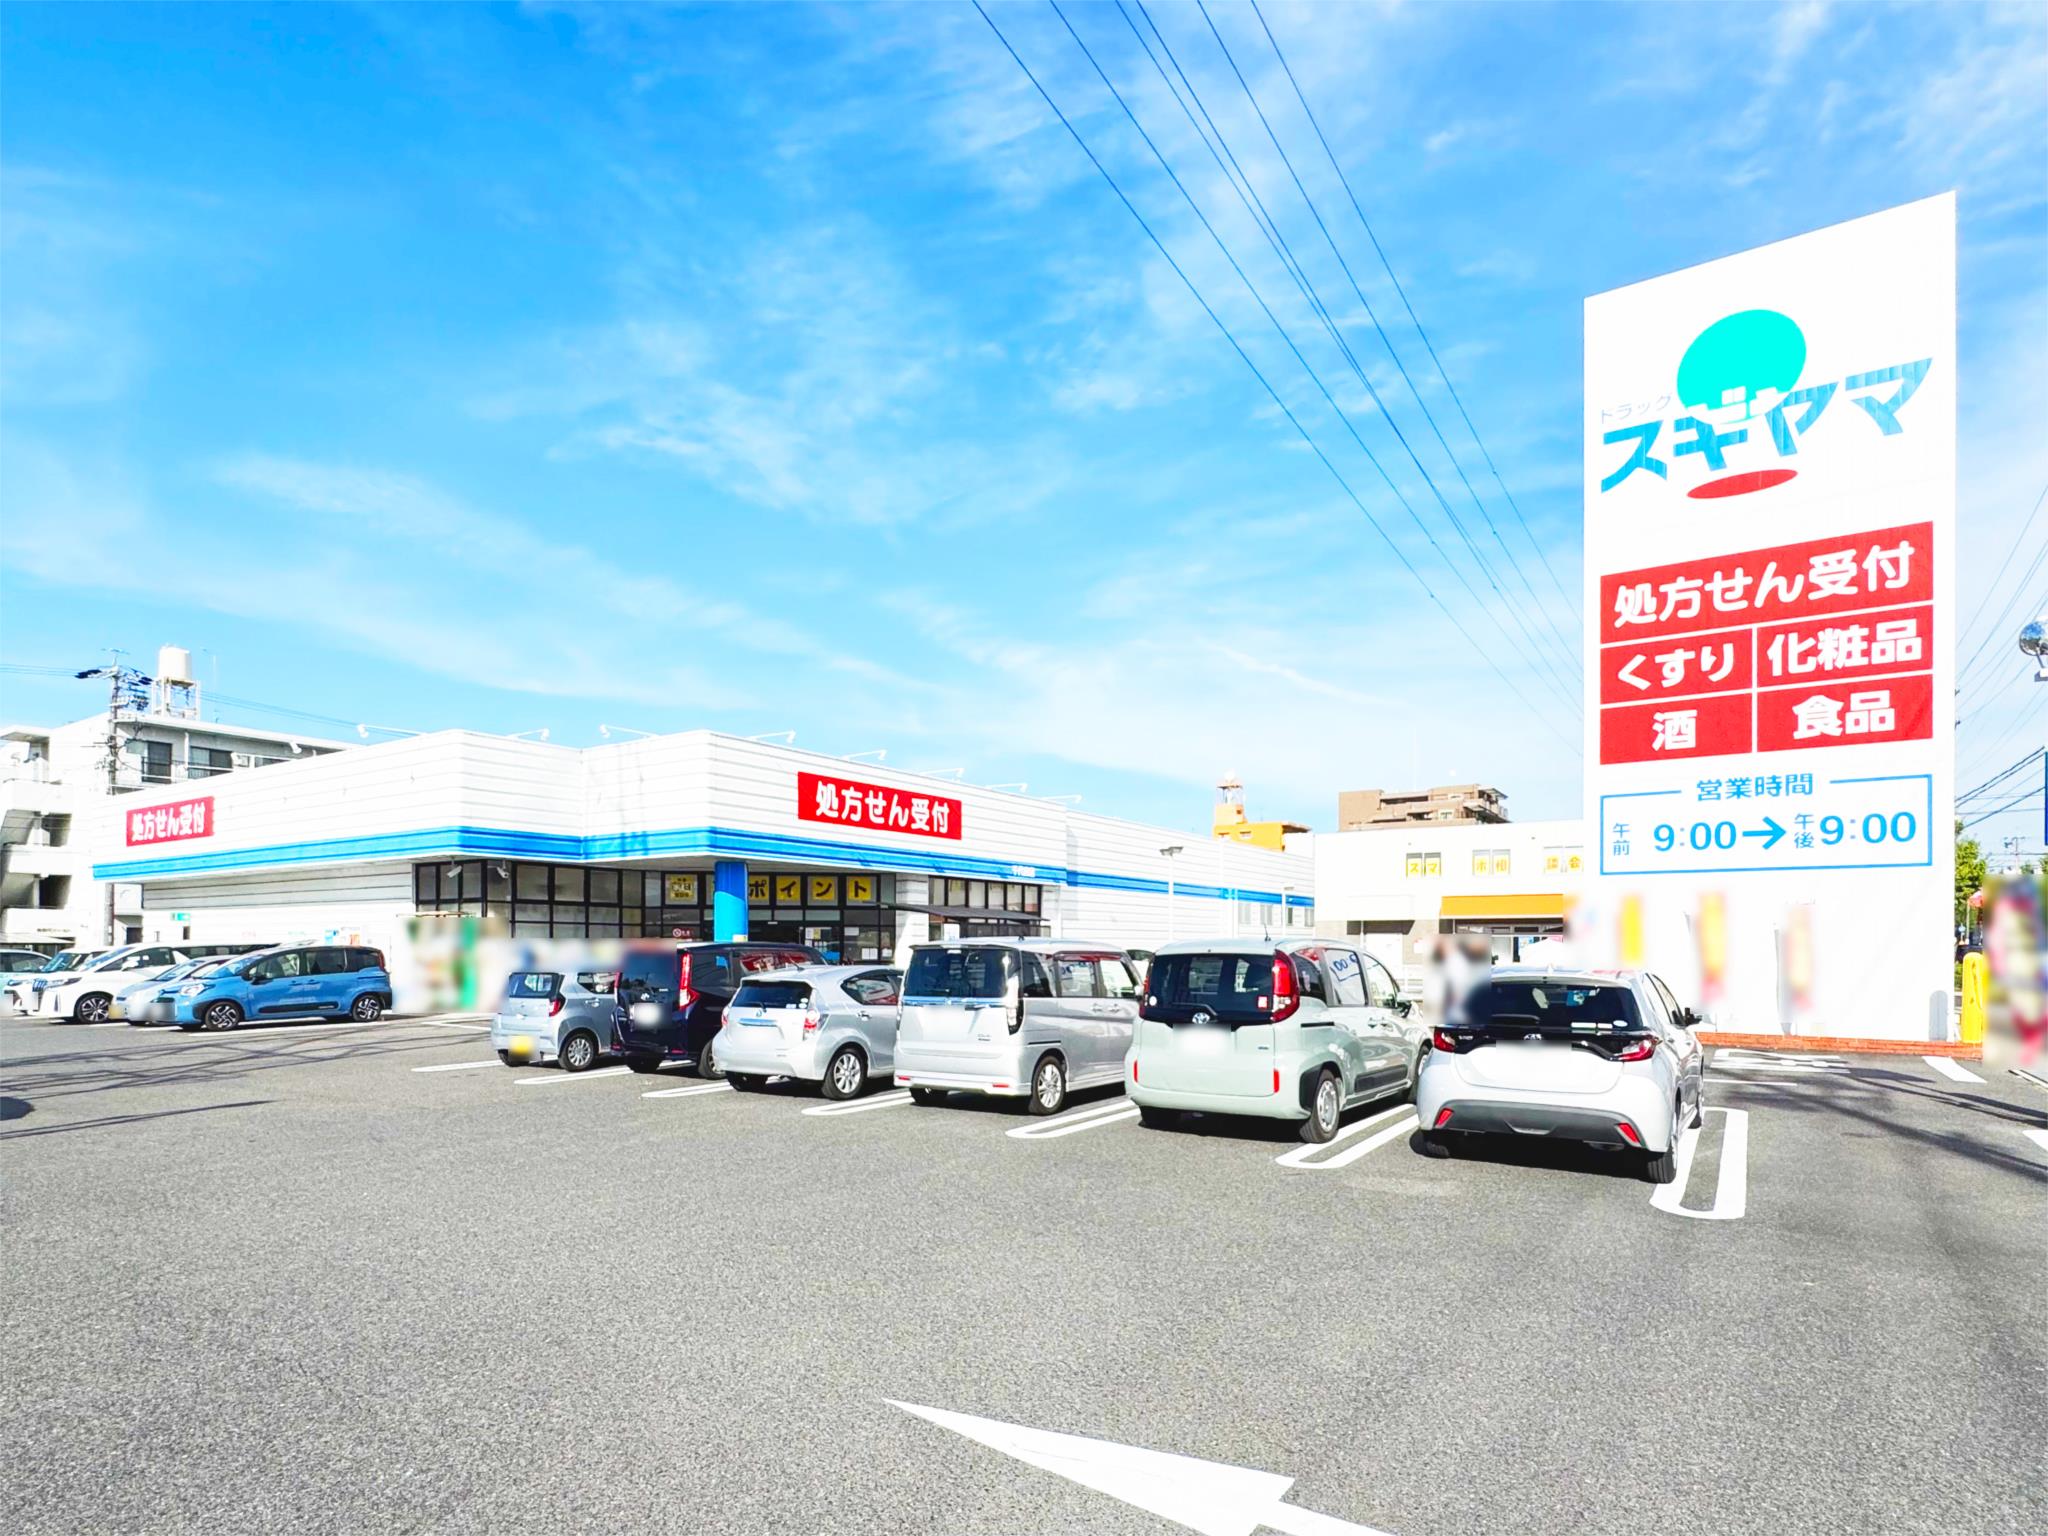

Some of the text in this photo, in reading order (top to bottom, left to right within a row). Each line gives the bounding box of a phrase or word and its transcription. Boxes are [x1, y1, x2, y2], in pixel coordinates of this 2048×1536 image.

[1614, 540, 1915, 629] 処方せん受付
[1617, 642, 1735, 691] くすり
[1767, 618, 1923, 677] 化粧品
[1652, 709, 1698, 751] 酒
[1792, 689, 1896, 741] 食品
[815, 780, 950, 835] 処方せん受付
[1696, 772, 1813, 802] 営業時間
[131, 801, 206, 842] 処方せん受付
[1612, 811, 1917, 856] 午前 9:00 午後 9:00
